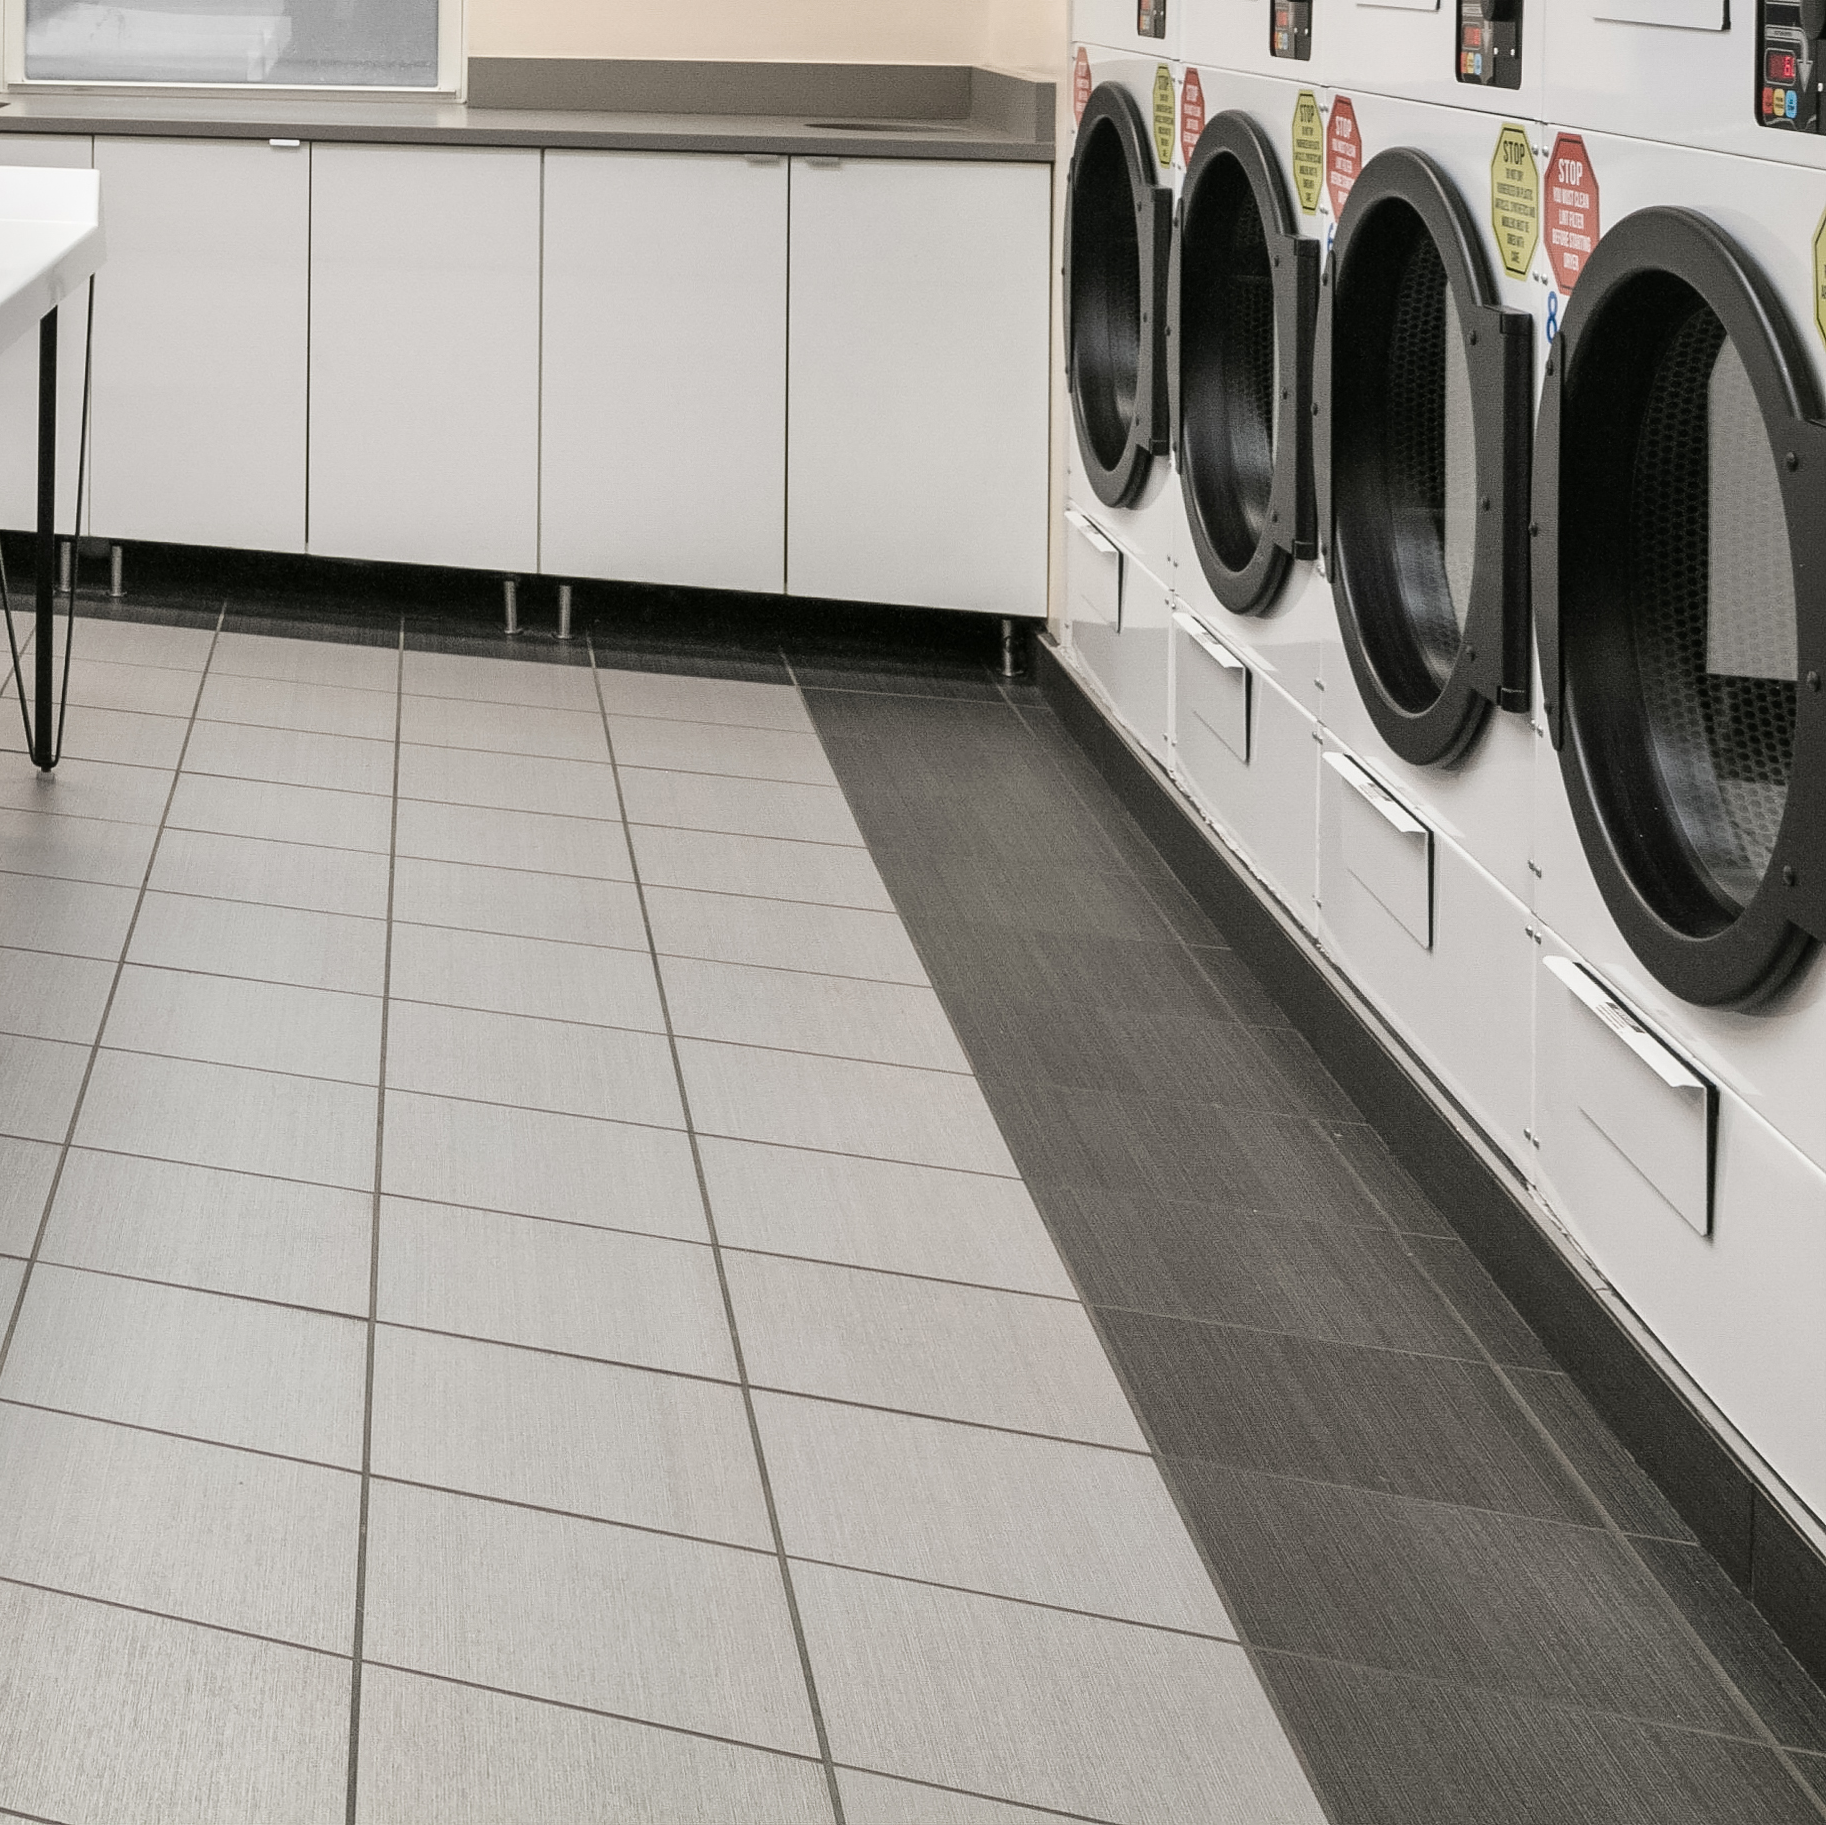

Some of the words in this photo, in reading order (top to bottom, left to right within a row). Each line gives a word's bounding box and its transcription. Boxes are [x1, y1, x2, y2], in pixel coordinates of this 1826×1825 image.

[1503, 140, 1525, 165] STOP
[1558, 158, 1583, 186] STOP
[1562, 188, 1574, 206] MUST
[1574, 191, 1590, 209] CLEAN
[1559, 209, 1568, 226] LINT
[1569, 212, 1584, 229] FILTER
[1552, 228, 1569, 248] BEFORE
[1570, 233, 1591, 253] STARTING
[1564, 252, 1579, 271] DRYER
[1547, 290, 1558, 344] 8
